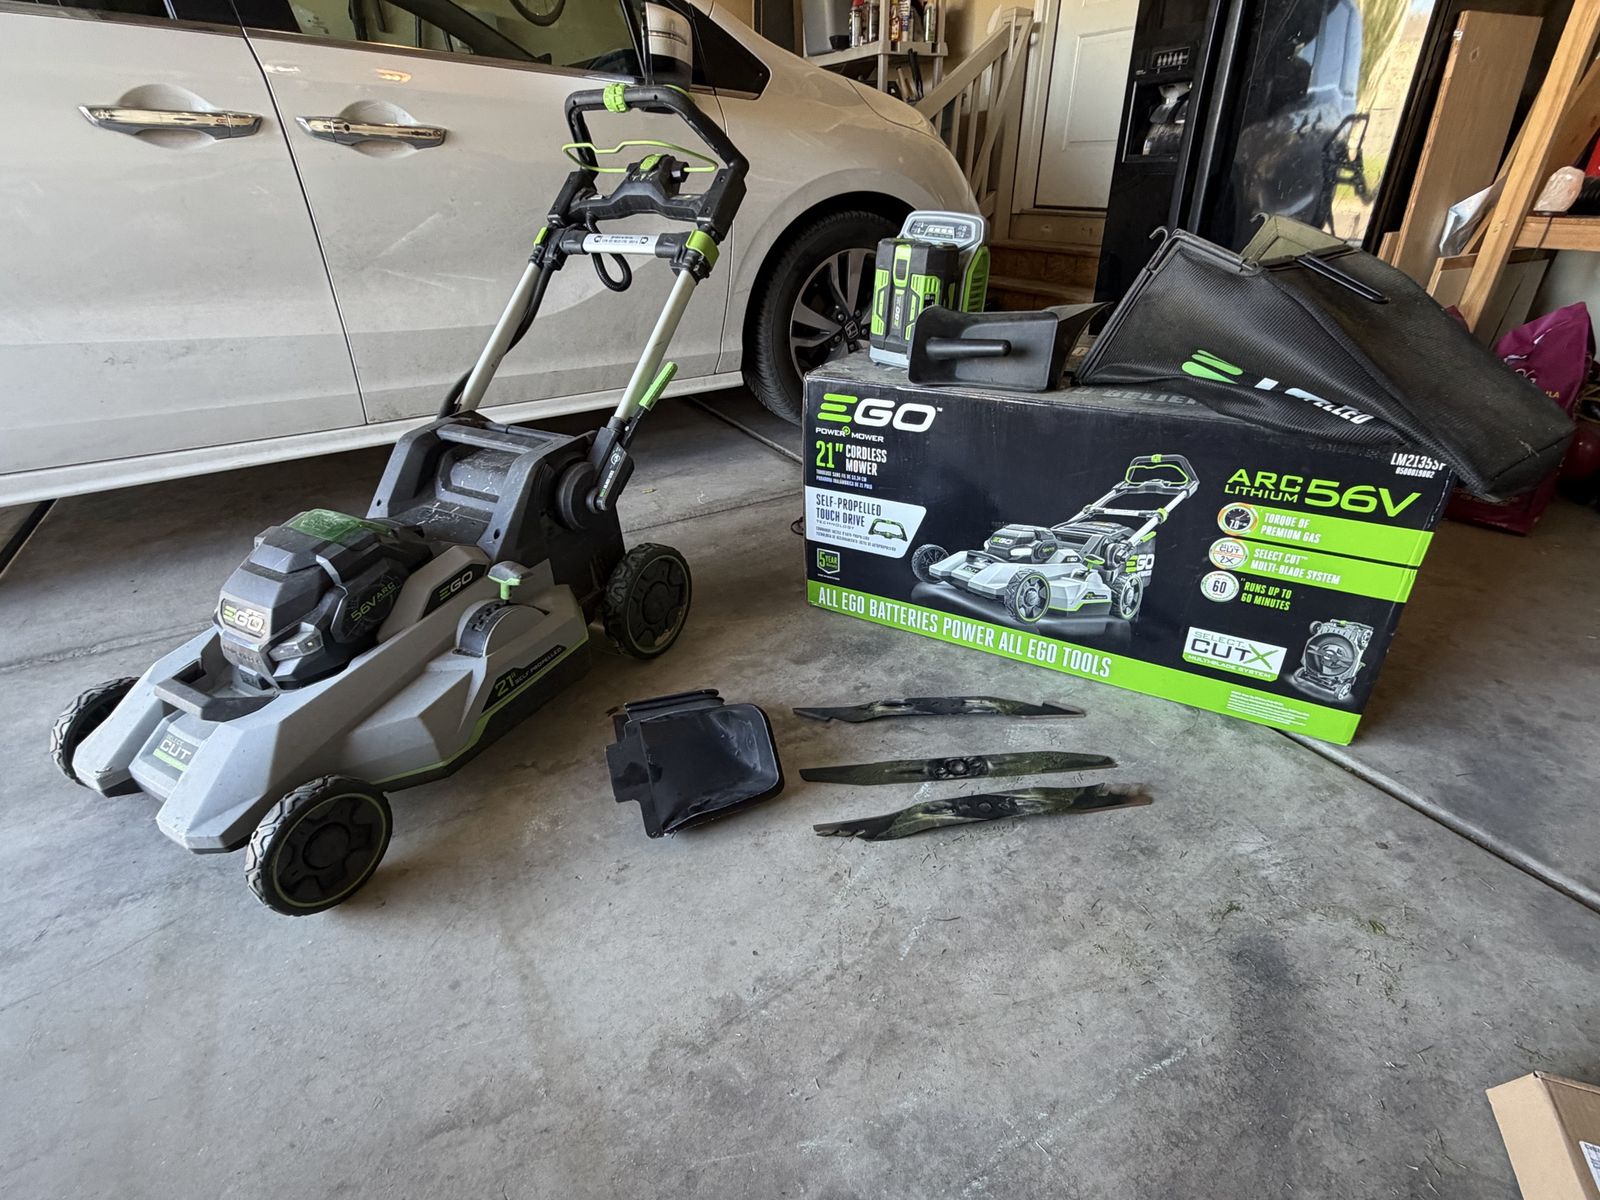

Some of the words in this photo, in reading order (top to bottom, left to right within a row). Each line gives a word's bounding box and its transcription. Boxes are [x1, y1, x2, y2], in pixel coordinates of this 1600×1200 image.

[817, 393, 937, 433] EGO
[851, 432, 884, 443] MOWER
[816, 440, 844, 469] 21"
[845, 444, 887, 463] CORDLESS
[845, 458, 878, 476] MOWER
[1224, 484, 1299, 503] LITHIUM
[1227, 468, 1304, 493] ARC
[1304, 478, 1422, 518] 56V
[815, 493, 882, 517] SELF-PROPELLED
[815, 507, 840, 522] TOUCH
[842, 511, 865, 527] DRIVE
[1264, 512, 1297, 528] TORQUE
[1300, 518, 1310, 529] OF
[1260, 525, 1301, 542] PREMIUM
[1302, 533, 1322, 544] GAS
[819, 551, 826, 567] 5
[1253, 548, 1283, 562] SELECT
[1250, 560, 1305, 579] MULTI-BLADE
[1306, 570, 1341, 585] SYSTEM
[438, 571, 474, 600] EGO
[1212, 579, 1227, 593] 60
[1244, 581, 1267, 595] RUNS
[1267, 585, 1280, 597] UP
[1281, 588, 1292, 600] TO
[350, 595, 378, 623] 56V
[1240, 592, 1251, 604] 60
[1253, 595, 1291, 611] MINUTES
[818, 587, 838, 608] ALL
[841, 591, 865, 614] EGO
[869, 597, 938, 633] BATTERIES
[942, 618, 994, 648] POWER
[998, 632, 1023, 656] ALL
[1027, 639, 1056, 664] EGO
[1061, 646, 1112, 678] TOOLS
[1194, 631, 1244, 648] SELECT
[1238, 663, 1271, 679] SYSTEM
[159, 739, 192, 760] CUT
